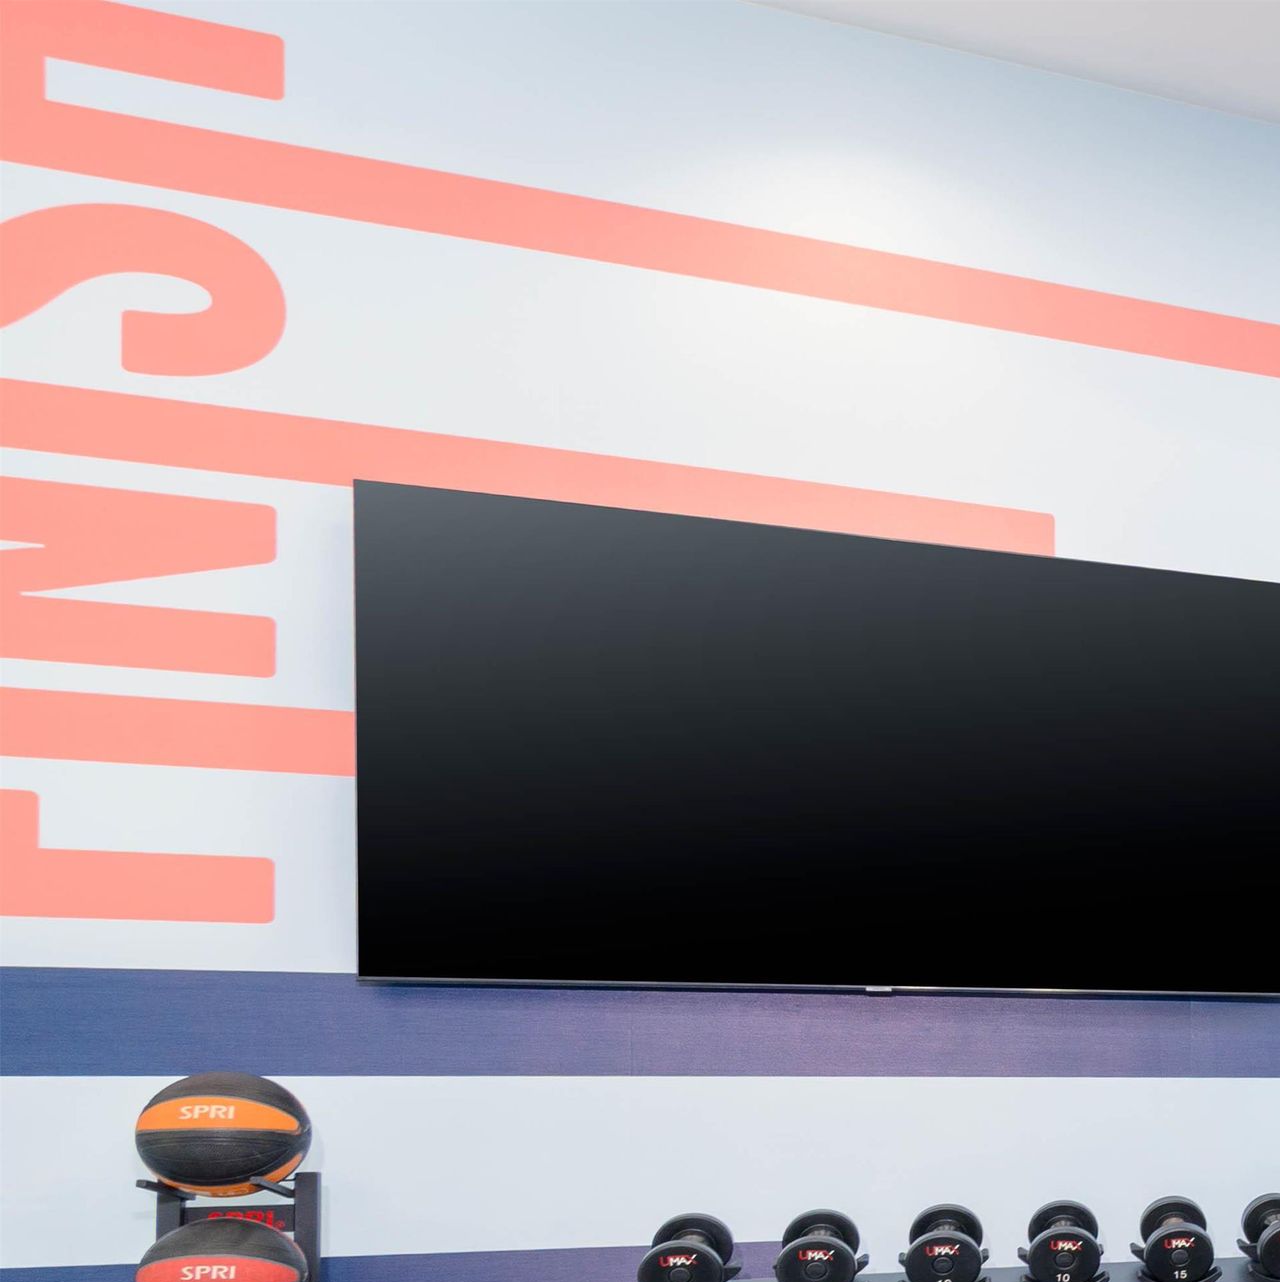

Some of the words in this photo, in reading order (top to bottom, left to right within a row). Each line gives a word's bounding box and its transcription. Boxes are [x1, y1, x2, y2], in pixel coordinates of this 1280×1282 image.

[178, 1104, 236, 1120] SPRI
[1049, 1239, 1083, 1251] UMAX
[1163, 1236, 1196, 1249] UMAX
[797, 1249, 835, 1261] UMAX
[924, 1244, 960, 1257] UMAX
[658, 1253, 697, 1268] UMAX
[179, 1264, 237, 1281] SPRI
[1056, 1273, 1071, 1282] 10
[1173, 1269, 1188, 1279] 15
